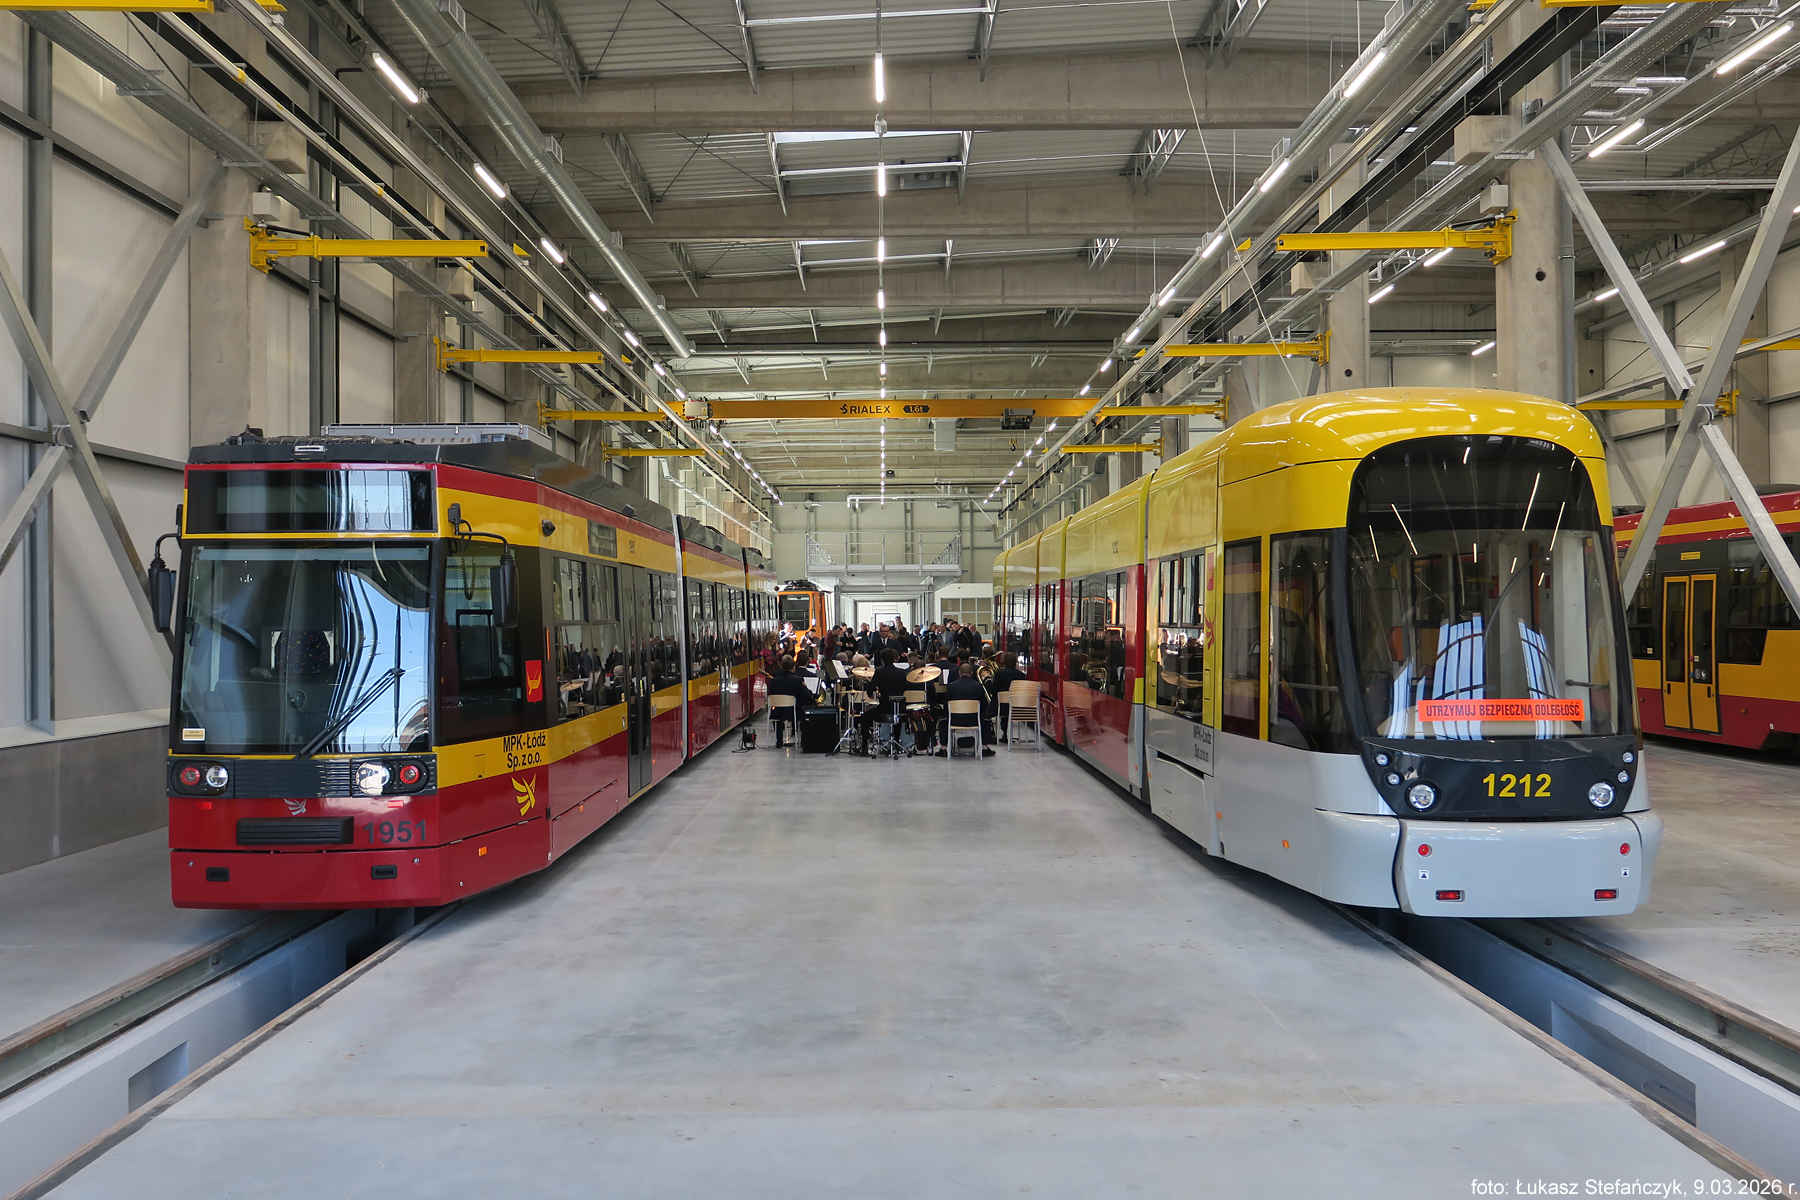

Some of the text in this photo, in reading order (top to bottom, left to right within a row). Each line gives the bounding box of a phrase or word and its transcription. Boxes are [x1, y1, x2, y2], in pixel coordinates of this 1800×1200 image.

[1426, 702, 1580, 719] UTRZYMUJ BEZPIECZNĄ ODLEGŁOŚĆ
[503, 731, 546, 753] MPK-Łódź
[1482, 773, 1552, 797] 1212
[363, 819, 426, 844] 1951
